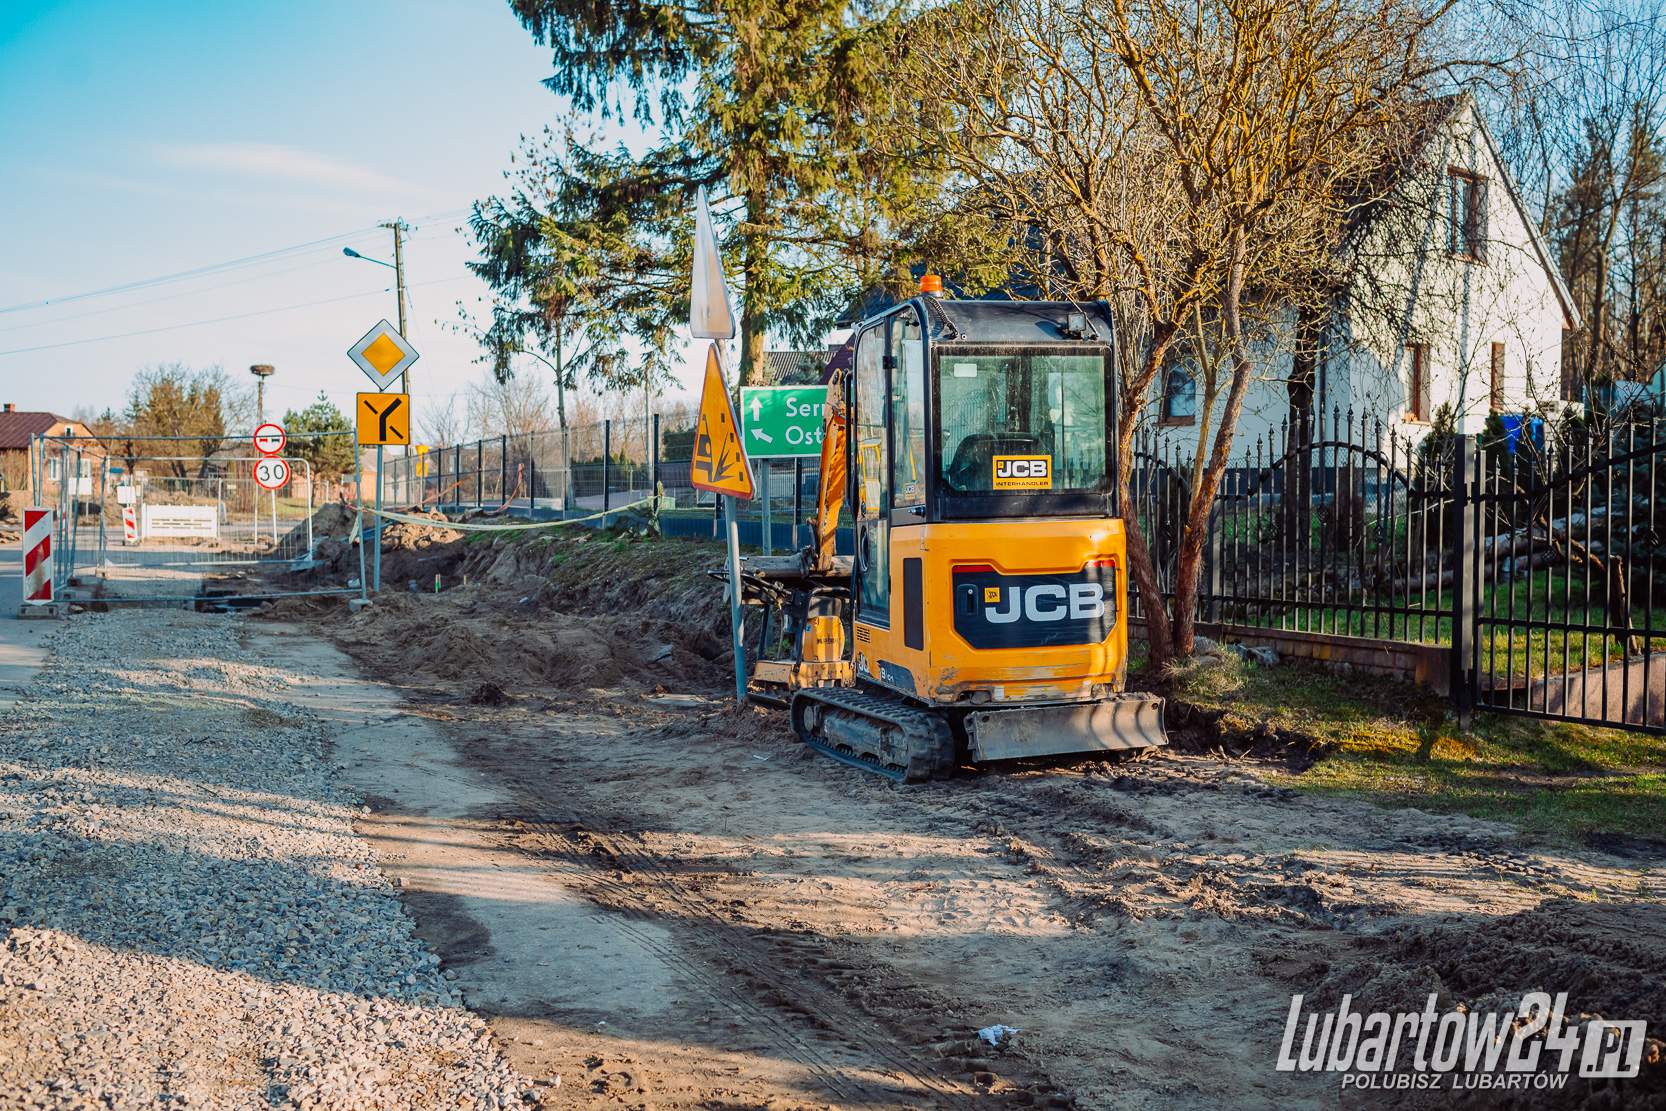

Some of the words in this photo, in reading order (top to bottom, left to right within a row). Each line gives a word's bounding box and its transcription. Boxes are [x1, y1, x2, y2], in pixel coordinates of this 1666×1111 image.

[259, 464, 285, 481] 30
[997, 461, 1047, 477] JCB
[985, 583, 1105, 623] JCB
